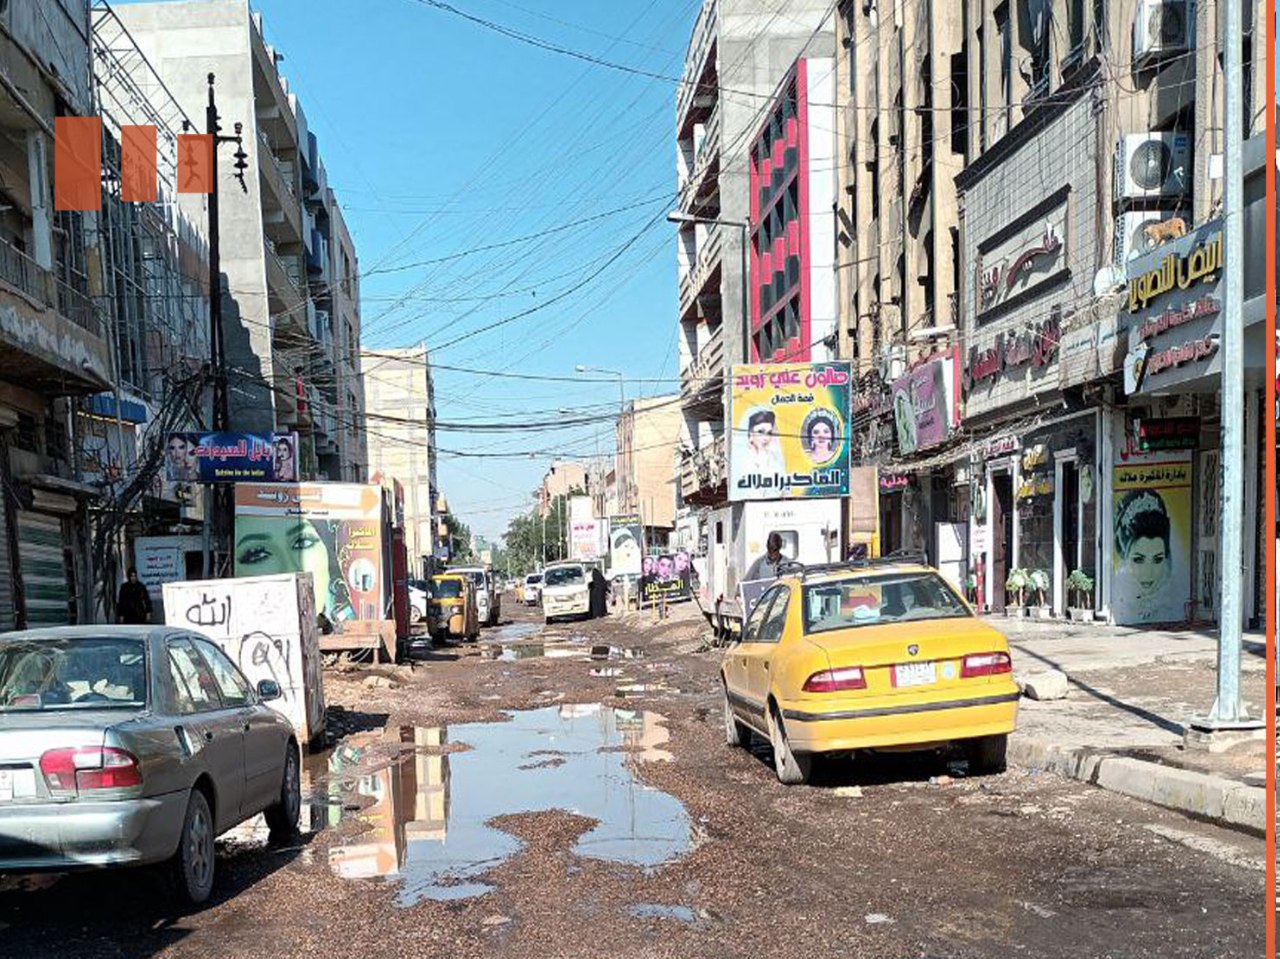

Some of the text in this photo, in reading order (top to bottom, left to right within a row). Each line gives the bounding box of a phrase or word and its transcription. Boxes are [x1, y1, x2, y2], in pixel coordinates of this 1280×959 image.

[736, 367, 849, 391] صالون علي زويد
